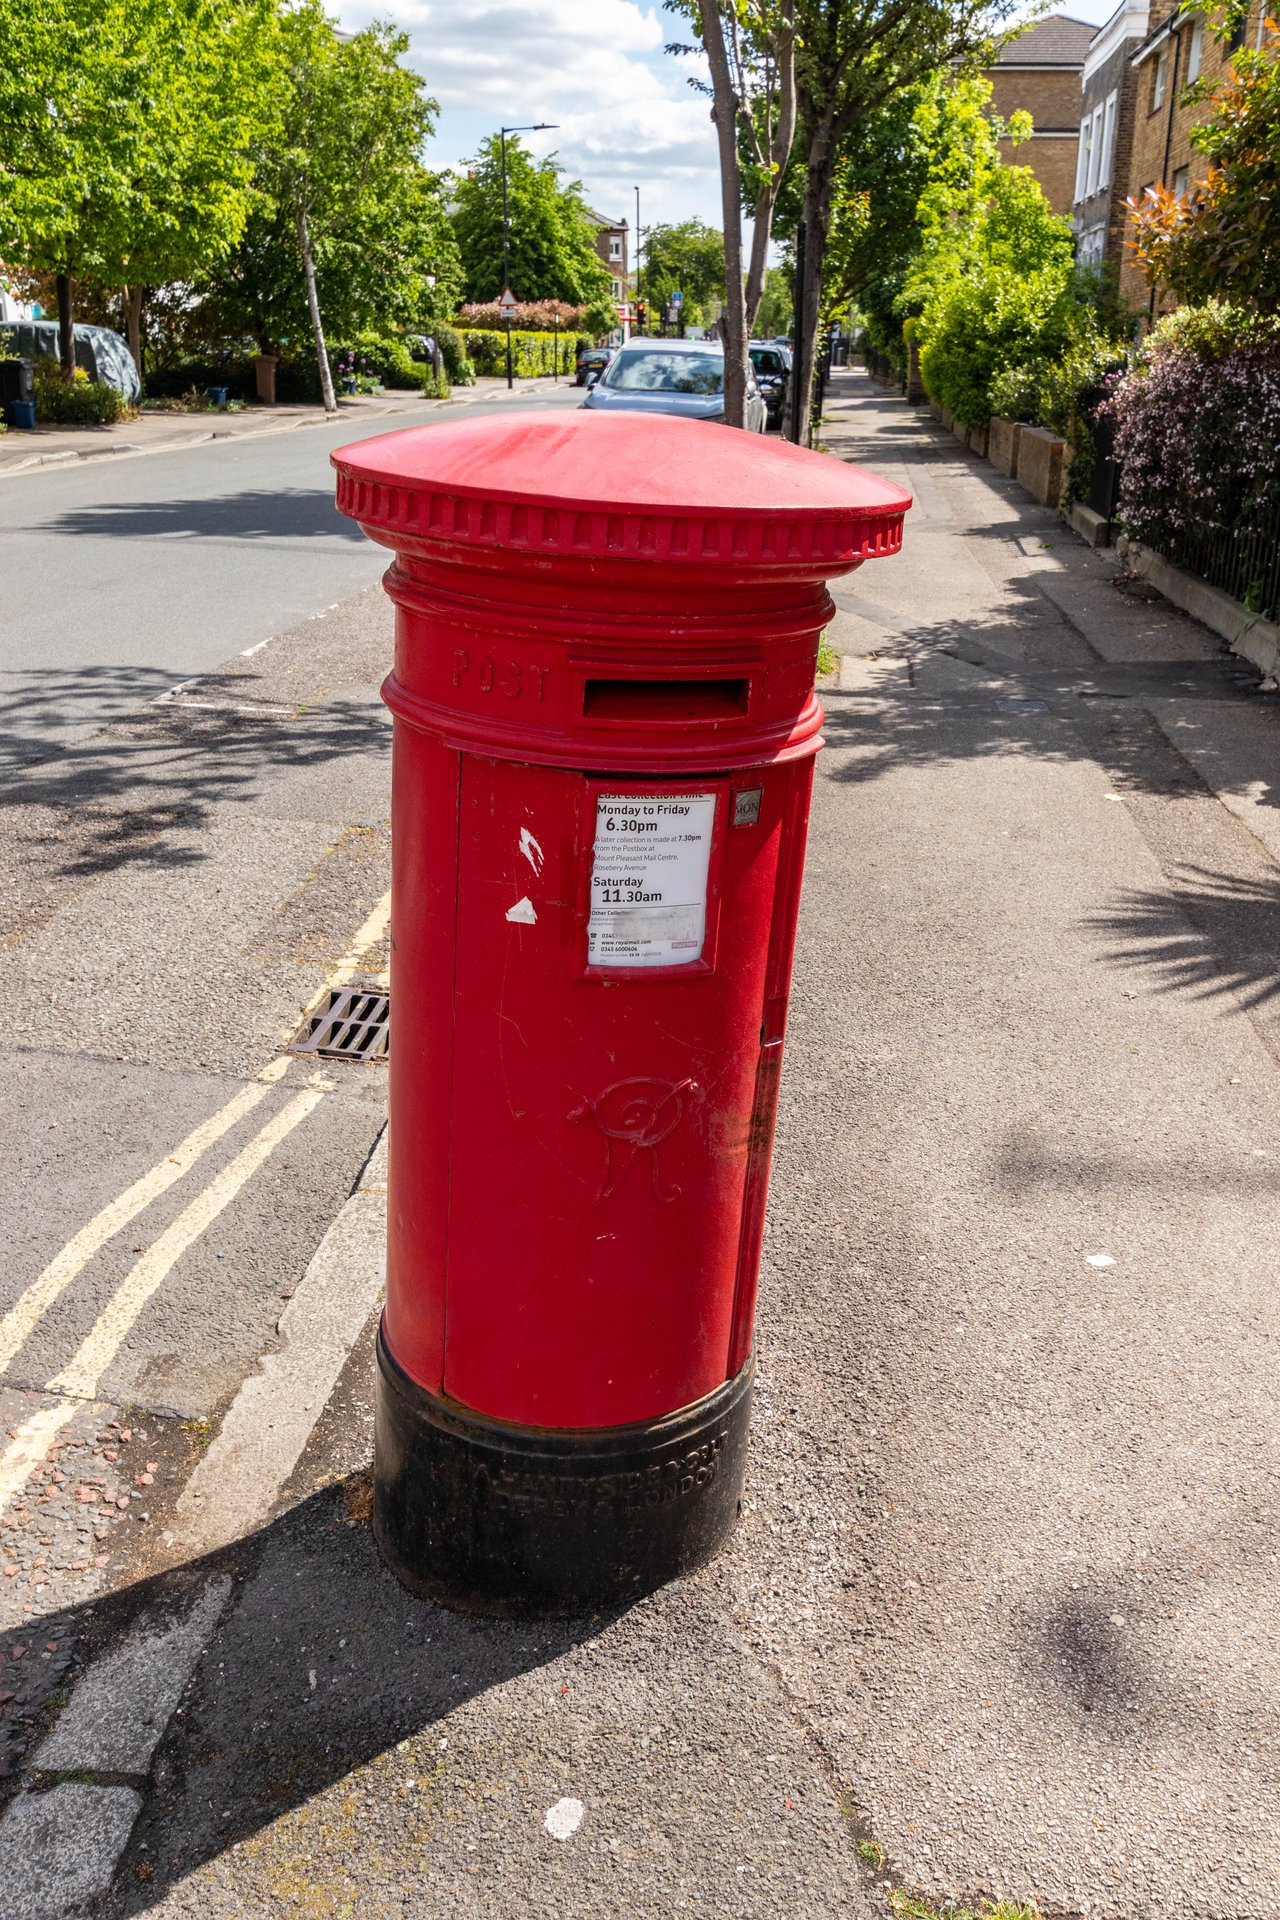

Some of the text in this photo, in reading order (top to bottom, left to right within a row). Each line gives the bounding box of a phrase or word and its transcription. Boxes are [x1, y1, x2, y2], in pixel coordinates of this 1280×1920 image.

[450, 648, 552, 702] POST
[598, 804, 690, 816] Monday to Friday
[606, 817, 658, 833] 6.30pm
[678, 834, 702, 842] 7.30pm
[593, 864, 623, 872] Rosebery
[593, 877, 643, 888] Saturday
[602, 889, 662, 903] 11.30am
